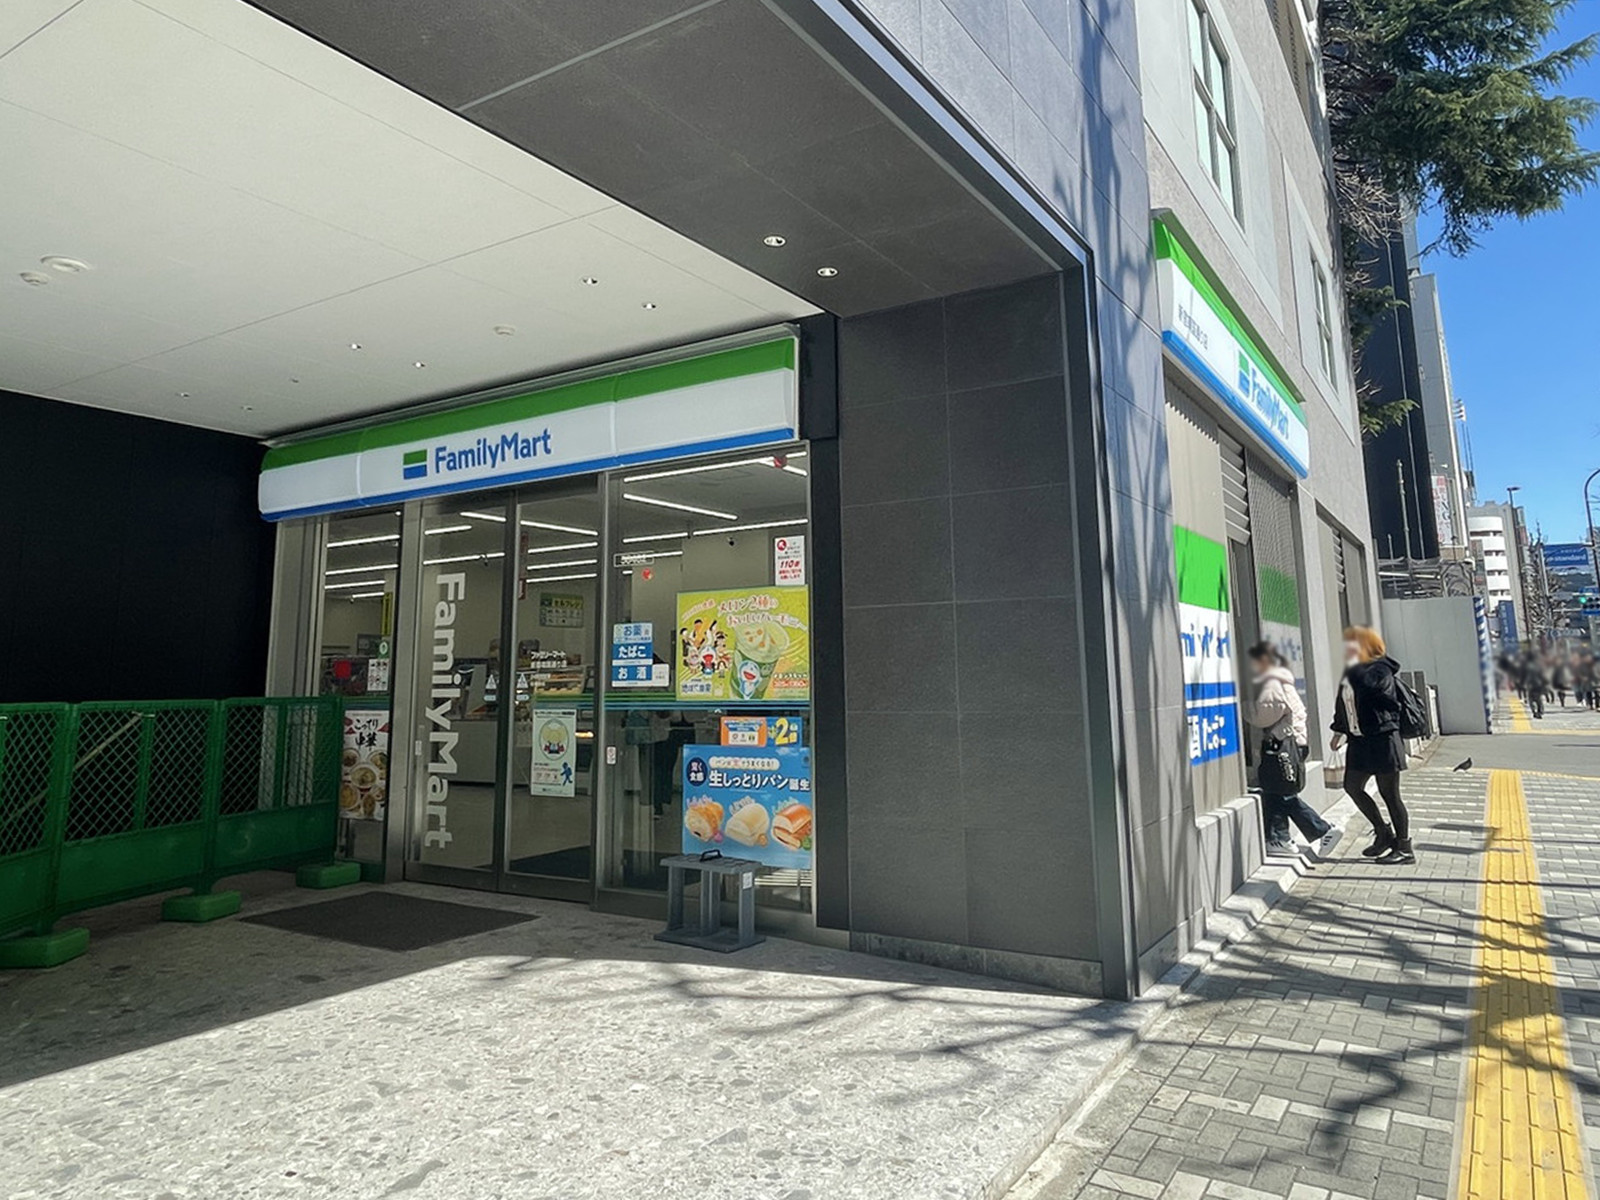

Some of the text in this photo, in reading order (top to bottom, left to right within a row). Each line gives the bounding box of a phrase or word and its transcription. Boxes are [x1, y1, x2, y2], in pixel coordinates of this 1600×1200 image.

[435, 428, 552, 474] FamilyMart
[618, 645, 647, 659] たばこ
[425, 572, 466, 849] FamilyMart
[354, 718, 379, 731] こってり
[354, 731, 378, 752] 中華
